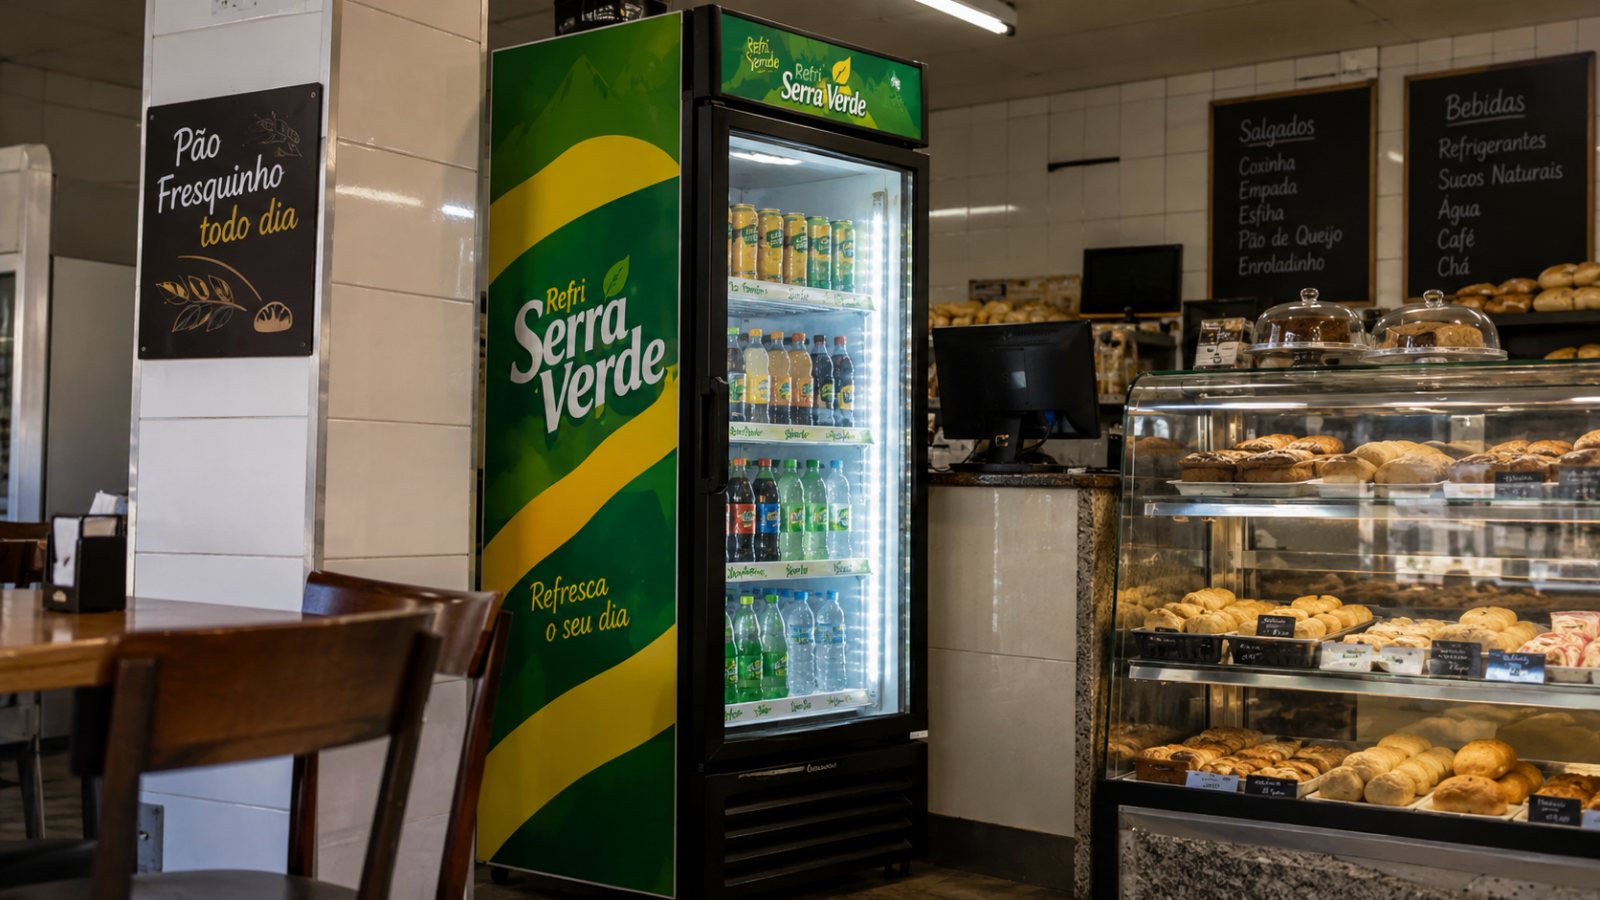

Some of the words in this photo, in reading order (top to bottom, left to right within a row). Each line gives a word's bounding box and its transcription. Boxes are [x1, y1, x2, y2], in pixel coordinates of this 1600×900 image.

[795, 63, 822, 82] Refri
[780, 71, 824, 108] Serra
[826, 83, 867, 117] Verde
[1445, 88, 1526, 121] Bebidas
[1239, 114, 1316, 147] Salgados
[1438, 131, 1547, 162] Refrigerantes
[173, 127, 221, 167] Pão
[1239, 153, 1296, 176] Coxinha
[1438, 168, 1484, 190] Sucos
[1491, 161, 1564, 185] Naturais
[156, 154, 285, 215] Fresquinho
[1239, 176, 1298, 203] Empada
[200, 204, 251, 248] todo
[258, 197, 299, 236] dia
[1239, 202, 1285, 227] Esfiha
[1437, 195, 1481, 226] Água
[1239, 230, 1266, 250] Pão
[1271, 227, 1289, 247] de
[1295, 225, 1343, 249] Queijo
[1437, 227, 1476, 252] Café
[1238, 252, 1325, 276] Enroladinho
[1437, 256, 1471, 277] Chá
[546, 278, 586, 315] Refri
[510, 297, 629, 384] Serra
[540, 325, 665, 433] Verde
[530, 576, 609, 614] Refresca
[546, 622, 557, 642] o
[562, 616, 593, 639] seu
[599, 600, 630, 631] dia
